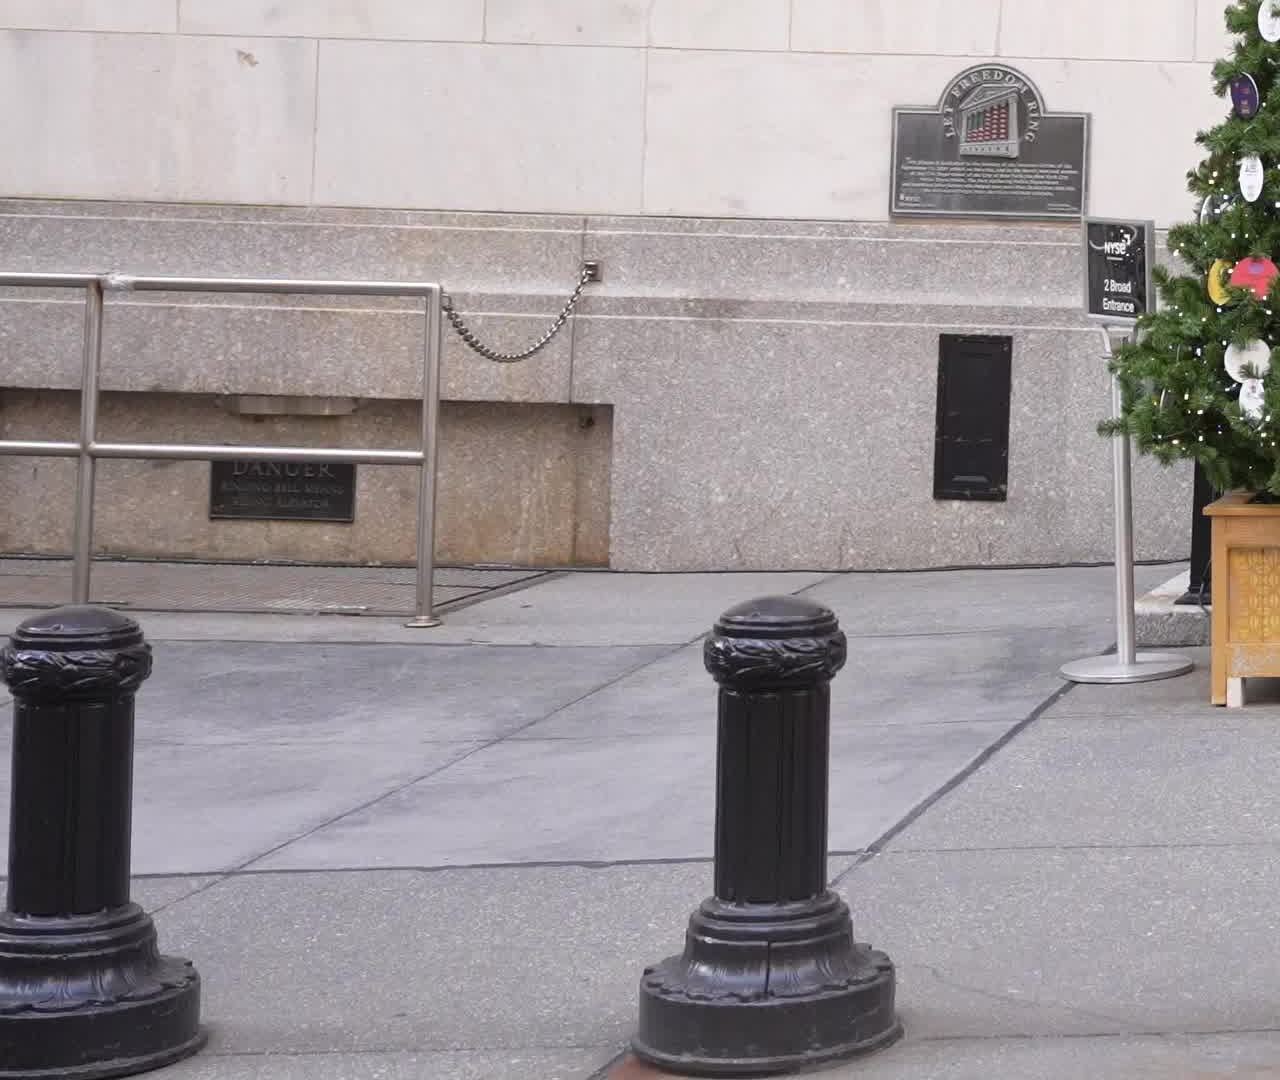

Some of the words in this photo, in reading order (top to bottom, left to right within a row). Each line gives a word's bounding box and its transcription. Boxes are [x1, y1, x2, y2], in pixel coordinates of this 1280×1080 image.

[943, 105, 956, 138] LET
[951, 70, 1028, 98] FREEDOM
[1024, 101, 1040, 142] RING
[1104, 279, 1109, 291] 2
[1110, 279, 1131, 293] Broad
[1103, 298, 1135, 312] Entrance
